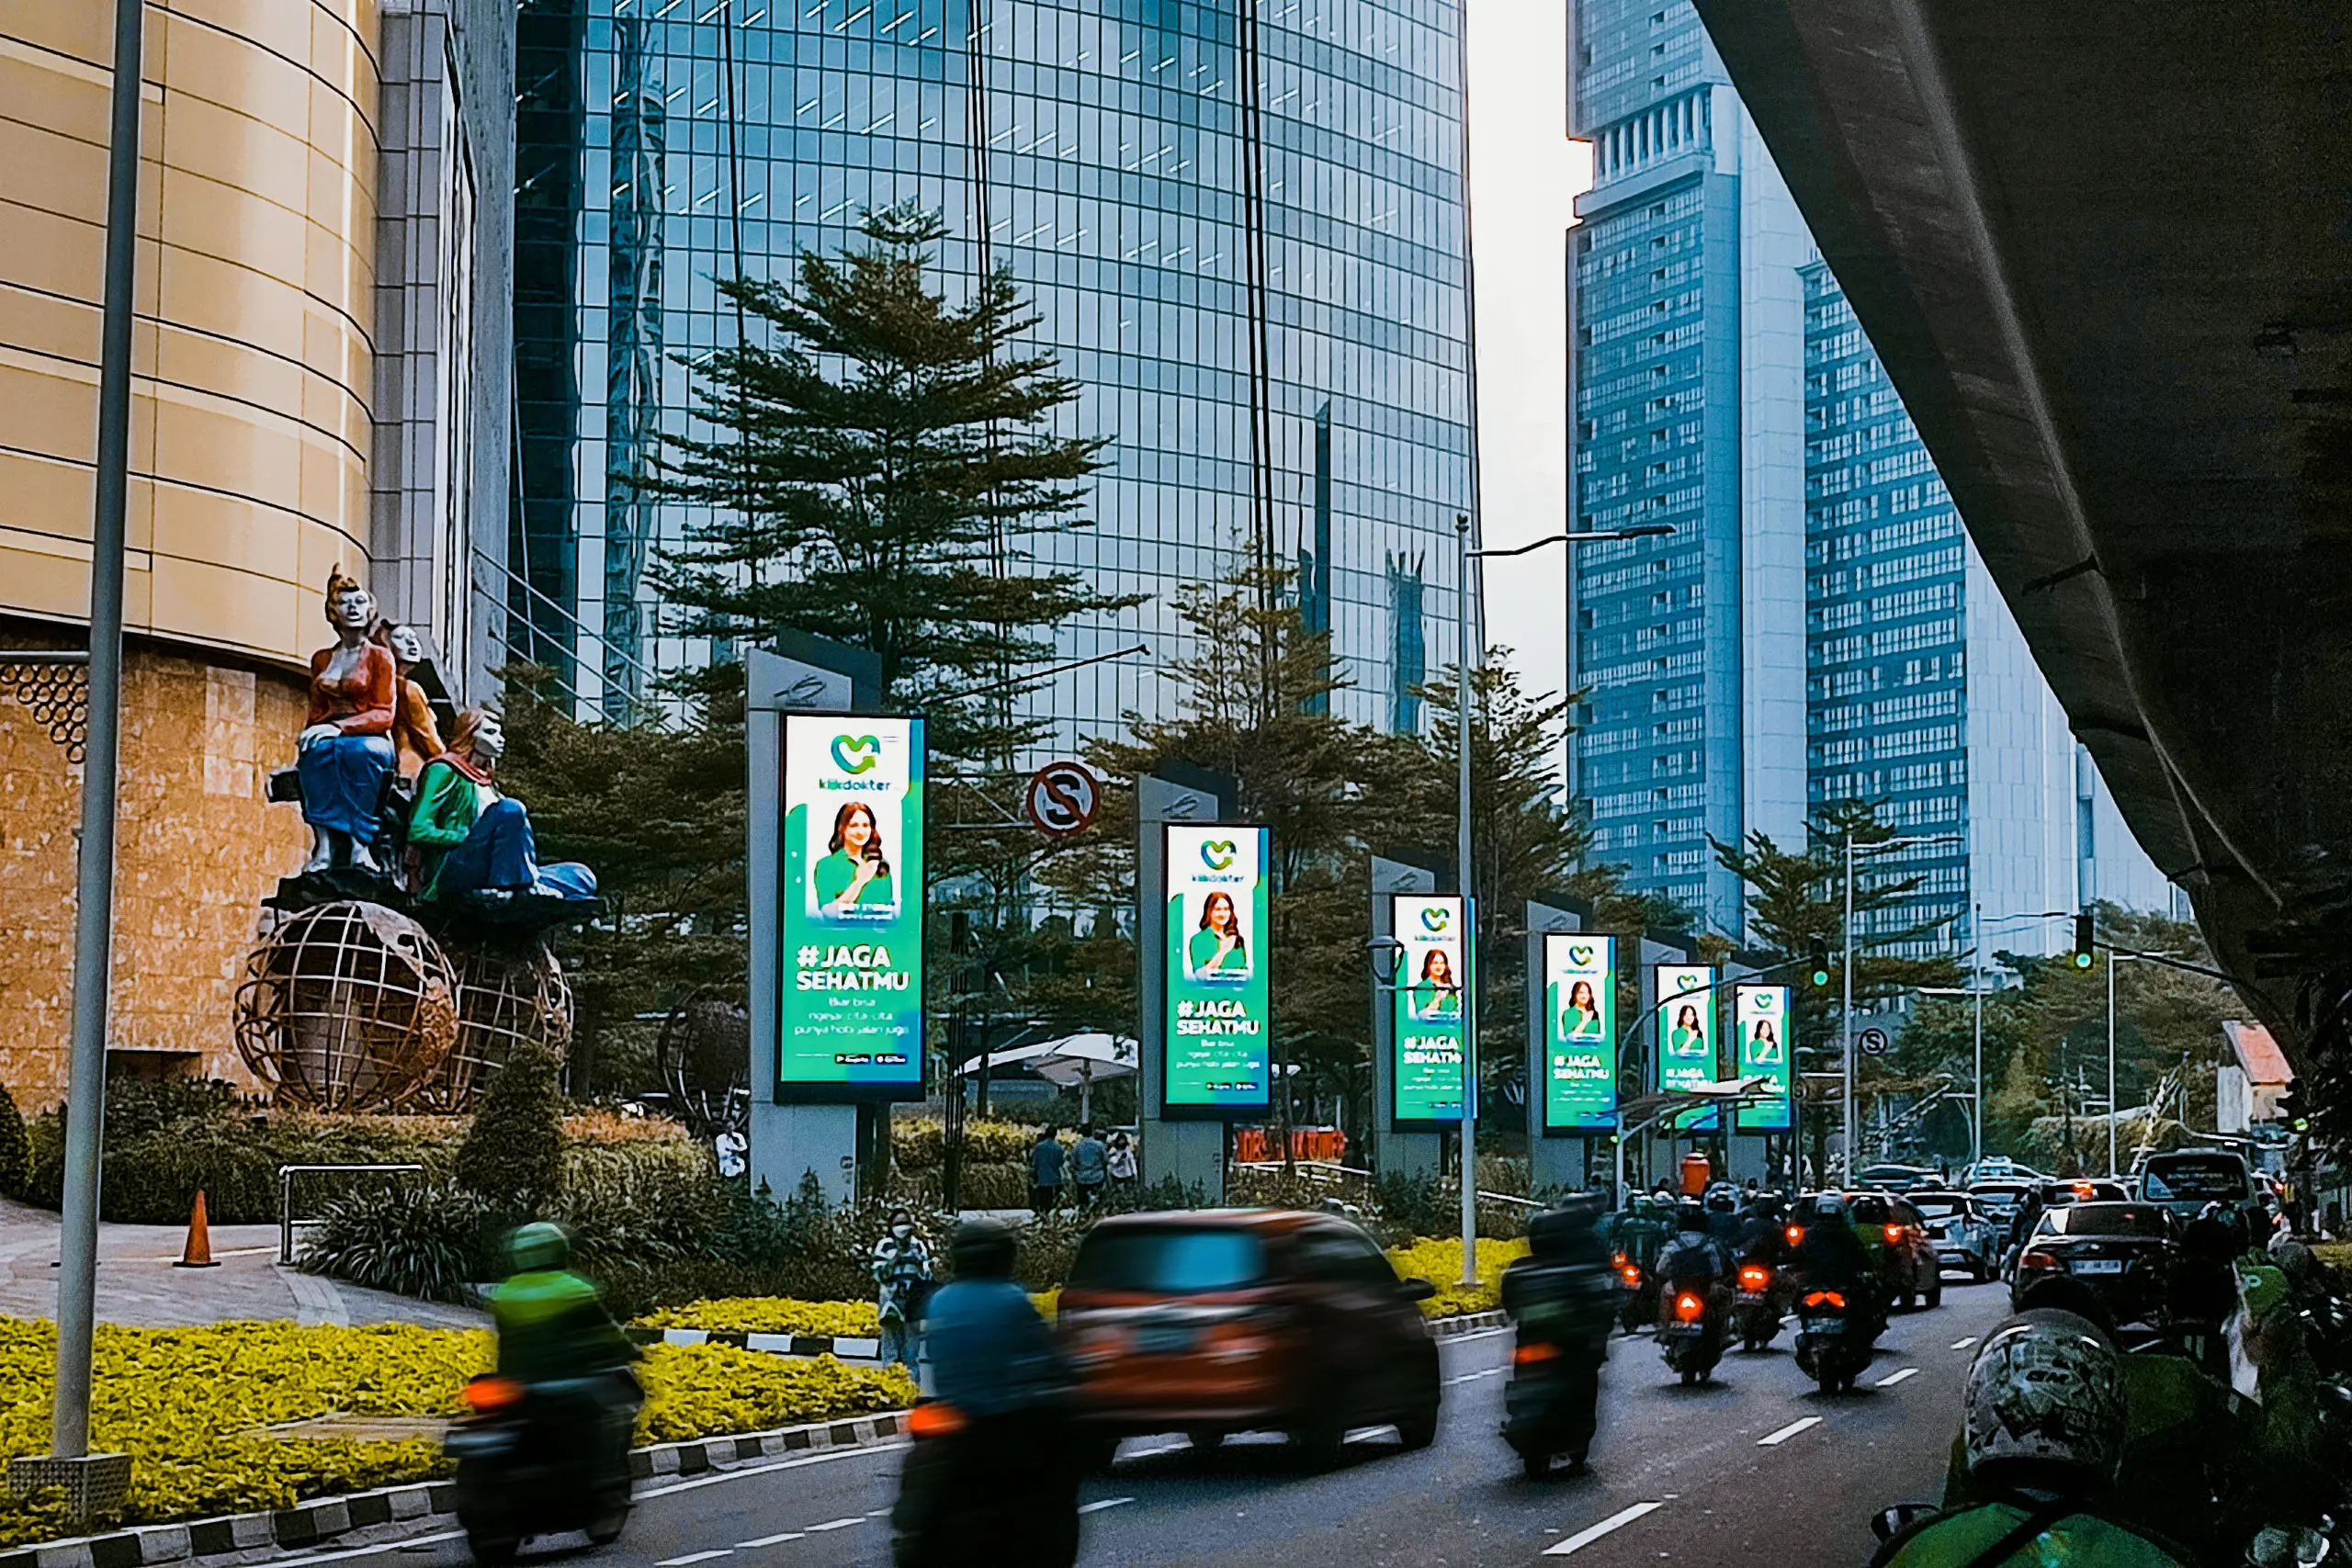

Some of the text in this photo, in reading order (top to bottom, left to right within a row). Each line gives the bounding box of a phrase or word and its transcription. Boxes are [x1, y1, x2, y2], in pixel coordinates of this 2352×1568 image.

[797, 945, 891, 968] #JAGA
[797, 971, 910, 991] SEHATMU
[1177, 1020, 1260, 1035] SEHATMU
